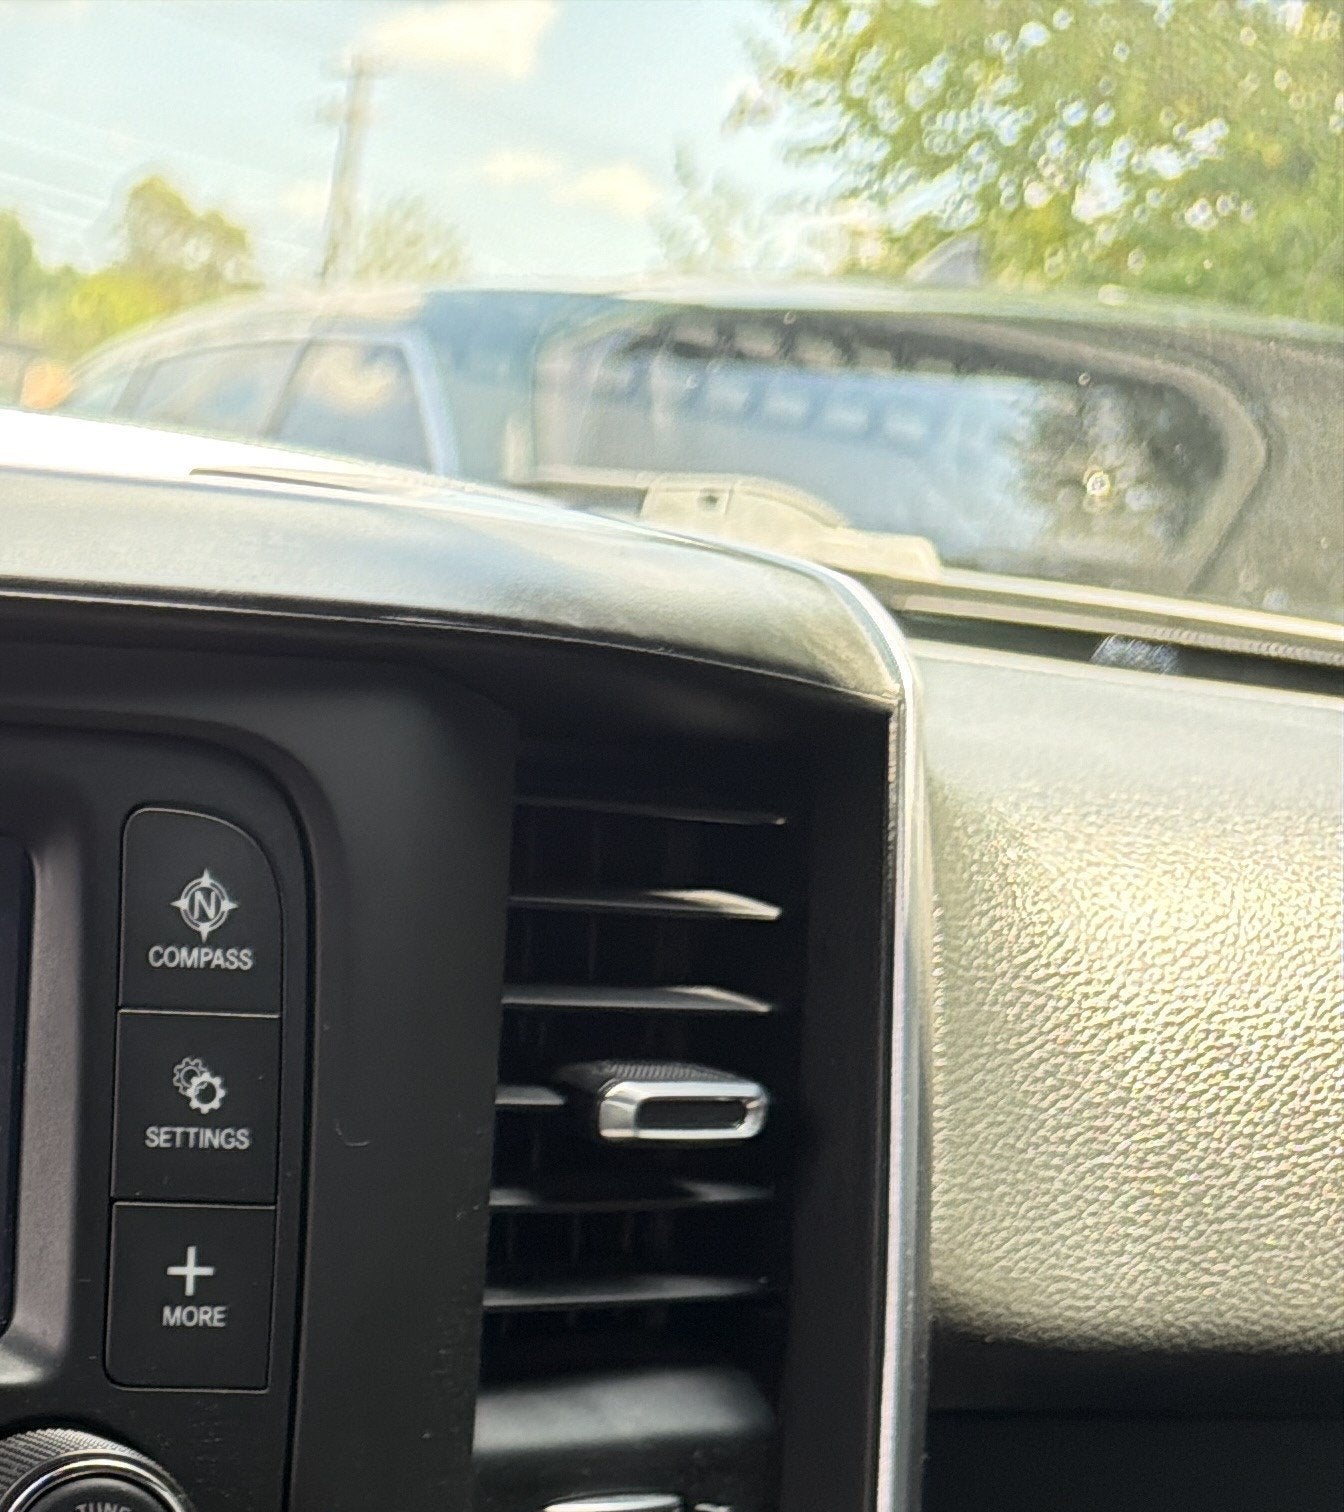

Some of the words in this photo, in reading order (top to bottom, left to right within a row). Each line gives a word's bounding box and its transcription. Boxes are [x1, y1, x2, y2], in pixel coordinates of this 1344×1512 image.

[148, 945, 254, 971] COMPASS
[145, 1126, 250, 1150] SETTINGS
[162, 1304, 226, 1328] MORE
